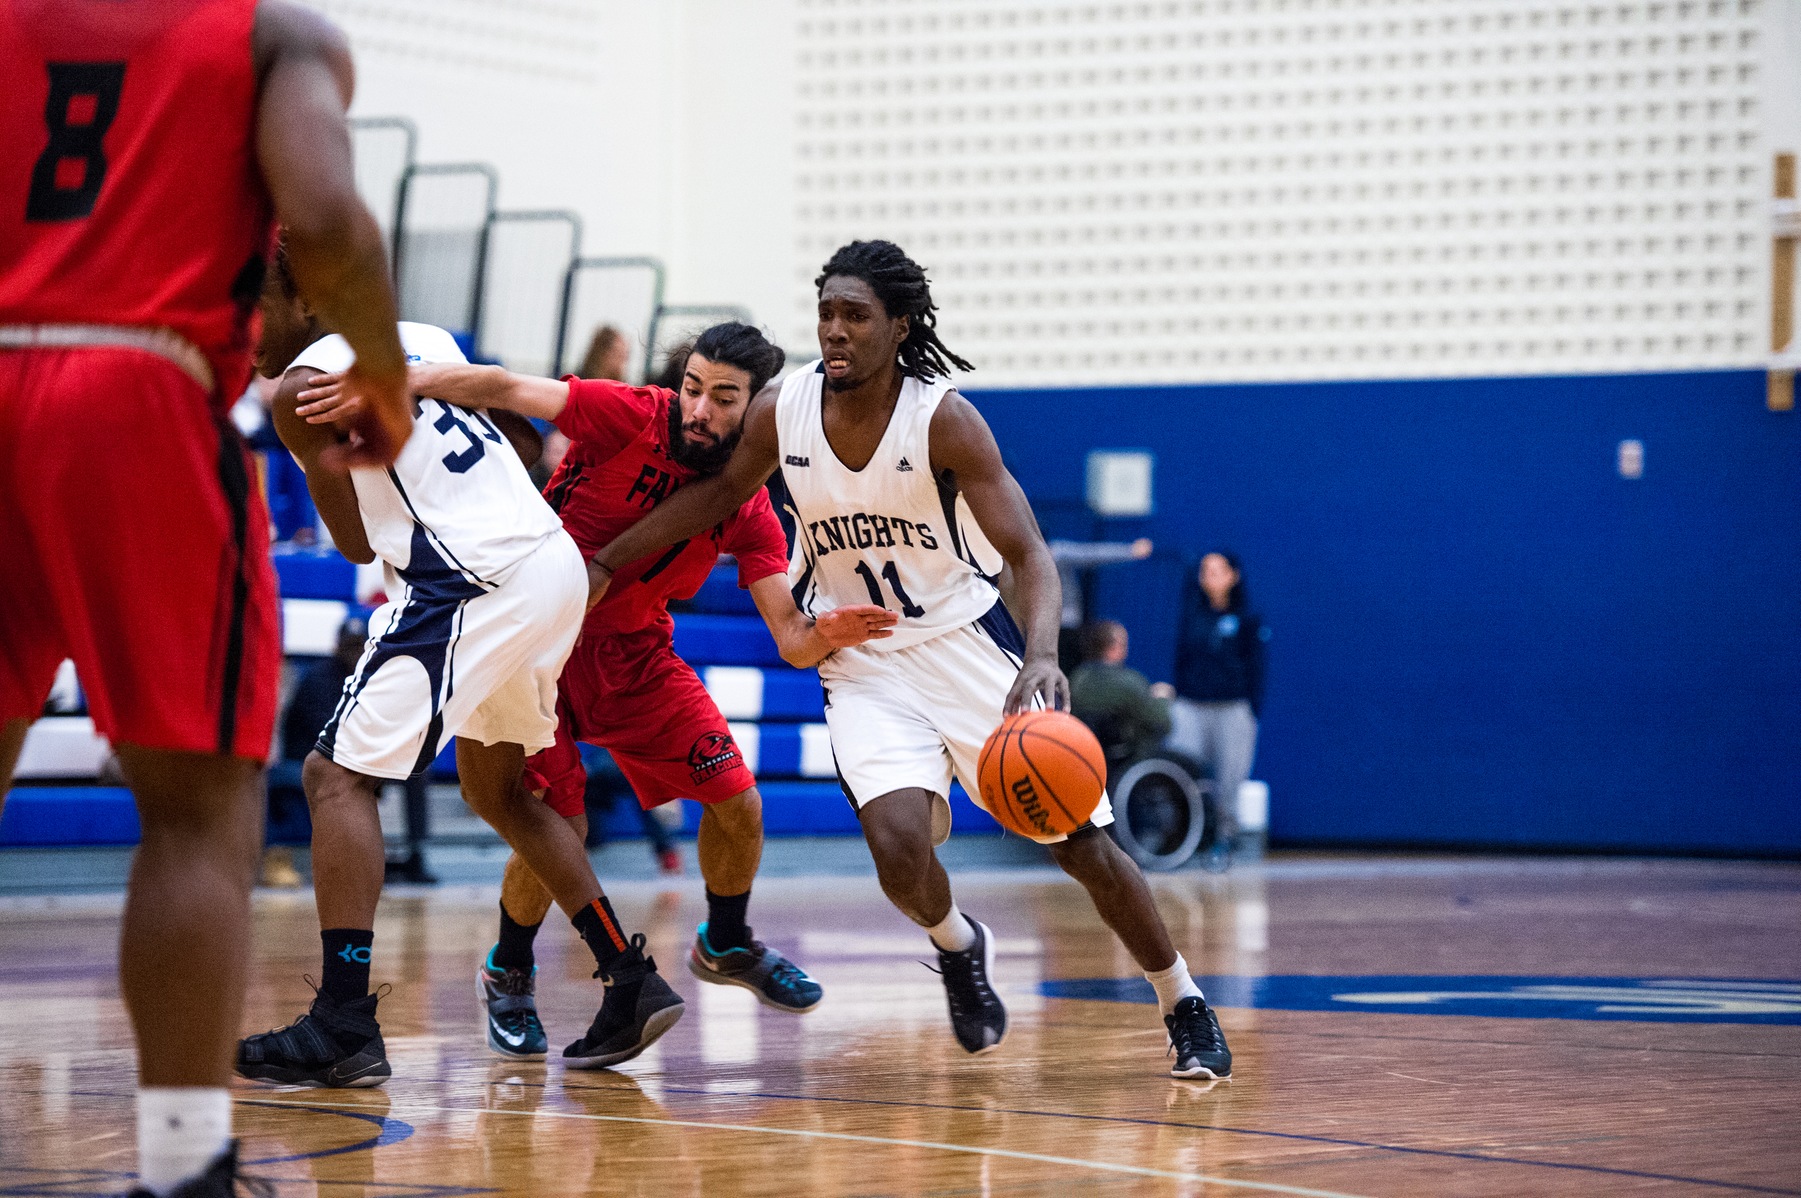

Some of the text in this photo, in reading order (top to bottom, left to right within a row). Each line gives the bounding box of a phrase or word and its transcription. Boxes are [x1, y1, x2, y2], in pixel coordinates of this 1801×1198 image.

[25, 61, 128, 223] 8
[808, 512, 939, 556] KNIGHTS
[854, 560, 926, 618] 11
